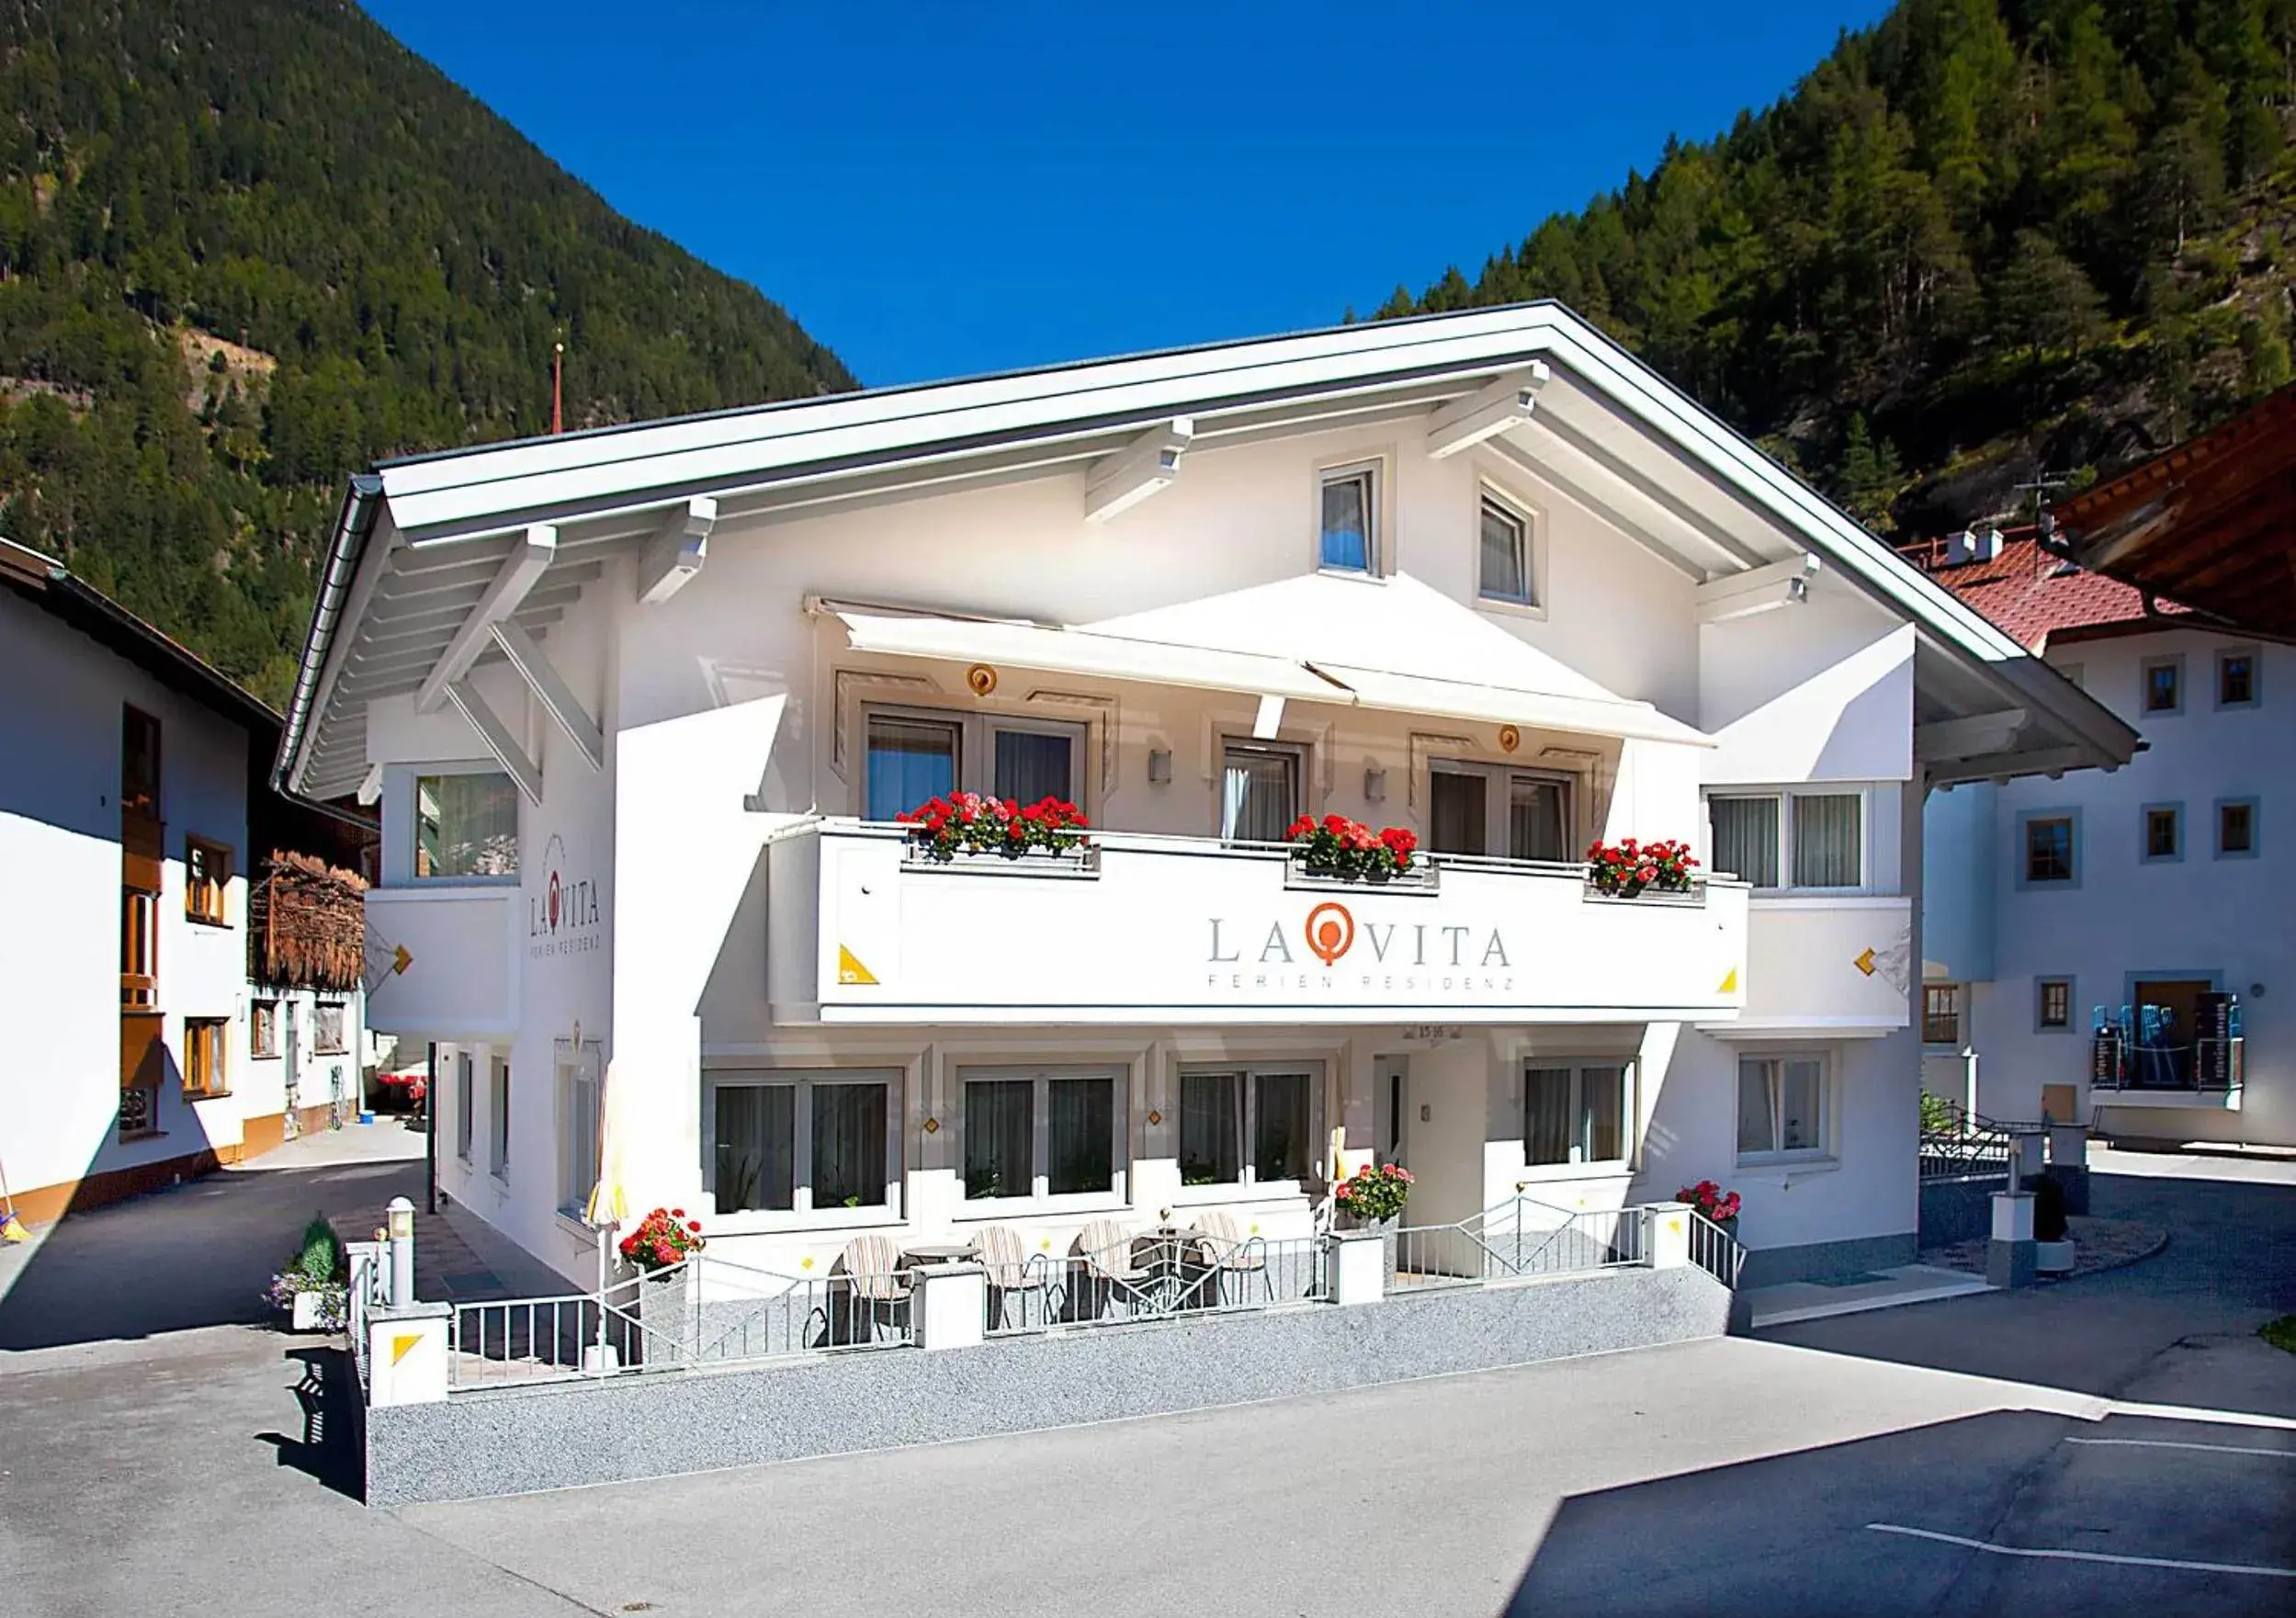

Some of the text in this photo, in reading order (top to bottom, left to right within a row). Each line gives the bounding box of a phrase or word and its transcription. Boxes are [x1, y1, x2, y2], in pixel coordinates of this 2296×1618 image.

[561, 878, 599, 928] VITA
[1206, 918, 1511, 967] LA VITA
[1207, 974, 1513, 990] FERIEN RESIDENZ
